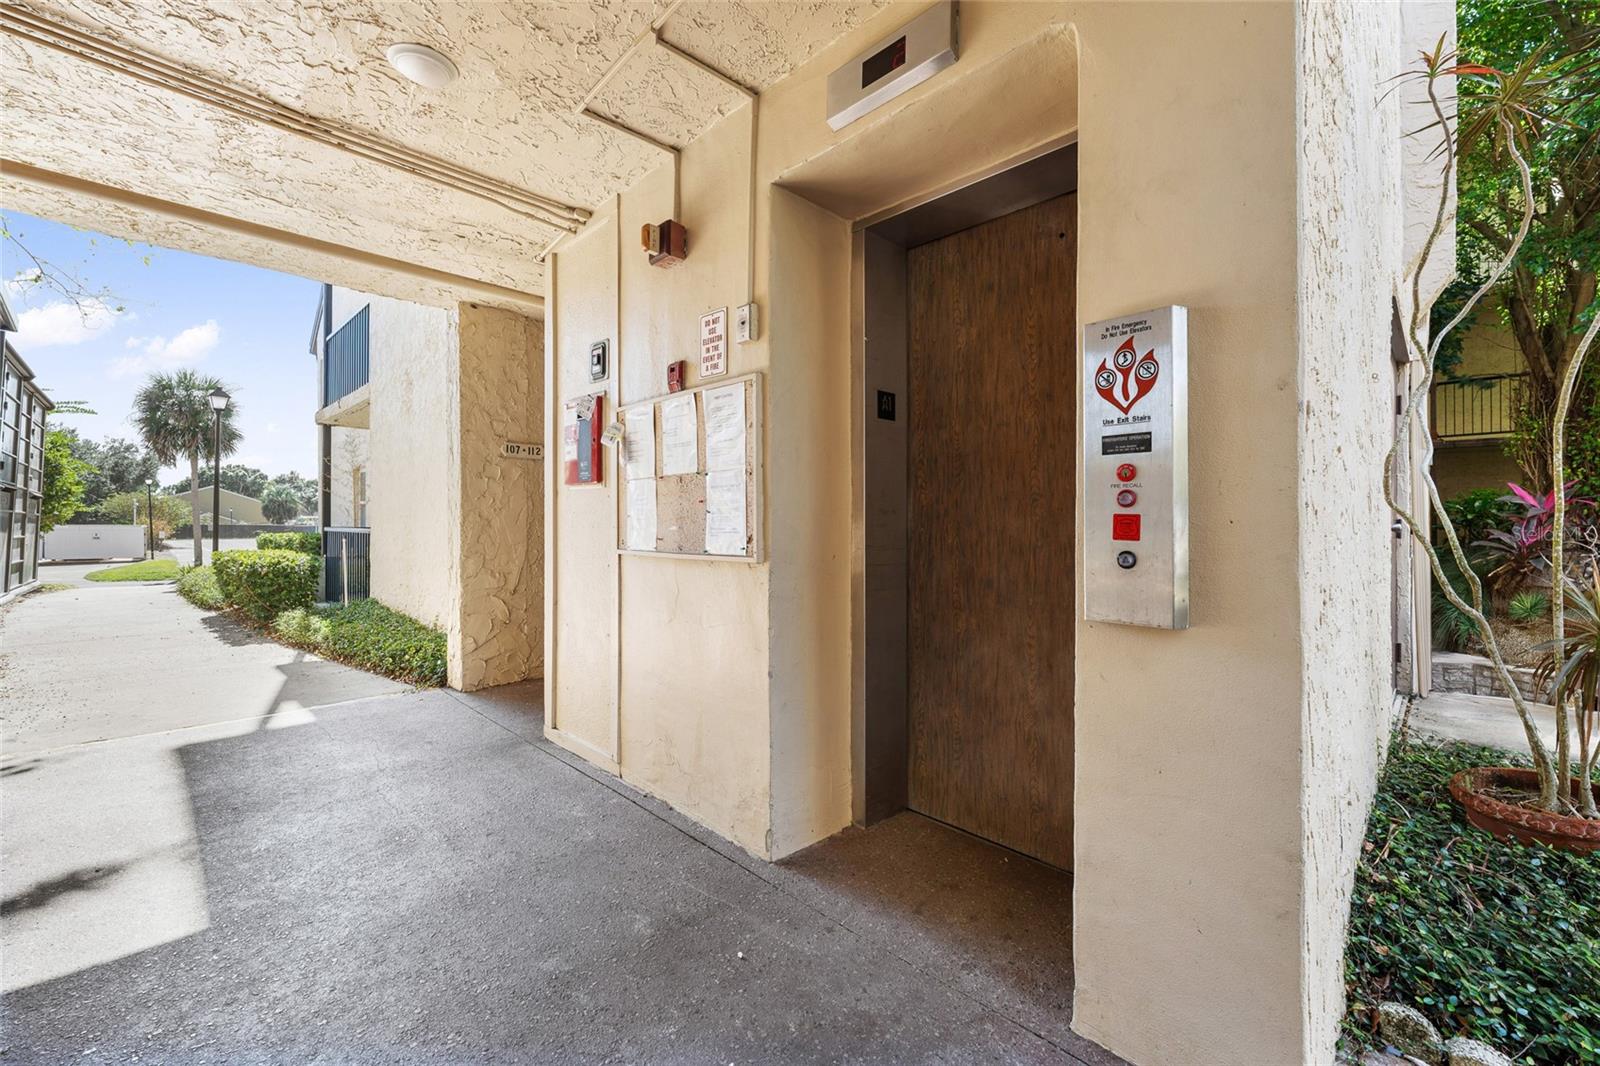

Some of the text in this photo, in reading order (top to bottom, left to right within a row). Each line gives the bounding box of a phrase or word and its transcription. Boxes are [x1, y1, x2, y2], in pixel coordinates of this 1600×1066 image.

[712, 316, 720, 325] NOT
[1122, 320, 1147, 329] Emergency
[708, 327, 716, 335] USE
[1130, 325, 1152, 334] Elevators
[703, 334, 722, 346] ELEVATOR
[703, 354, 715, 364] EVENT
[710, 362, 719, 370] FIRE
